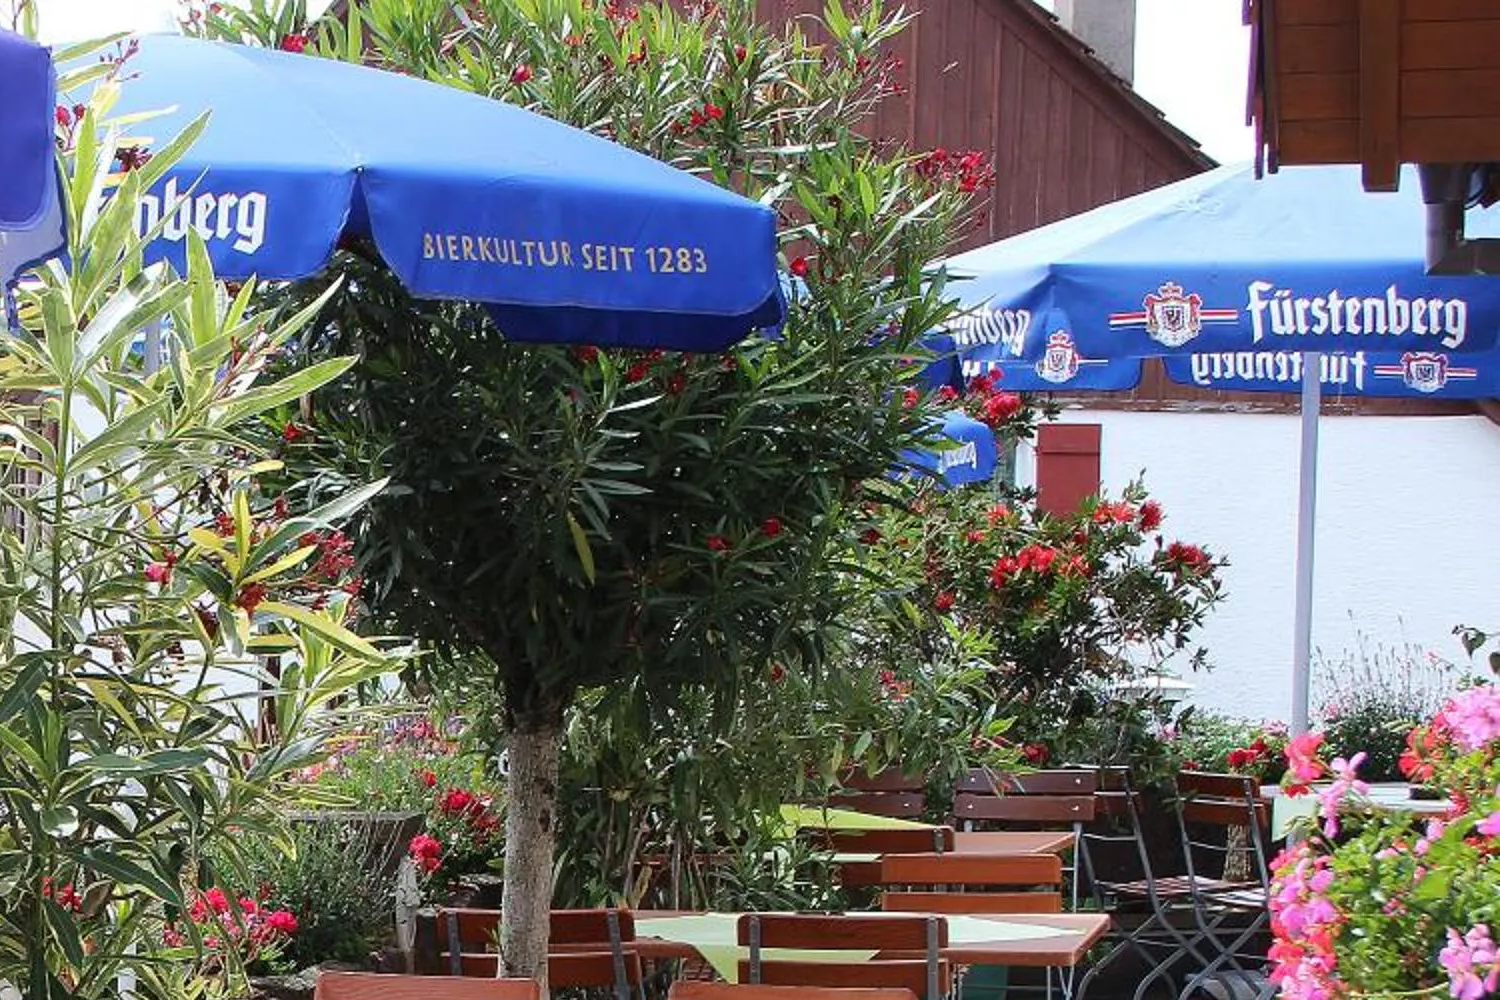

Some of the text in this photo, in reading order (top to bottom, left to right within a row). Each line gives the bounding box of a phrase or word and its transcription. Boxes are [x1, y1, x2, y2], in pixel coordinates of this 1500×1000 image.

[132, 176, 267, 254] nberg
[423, 233, 707, 273] BIERKULTUR SEIT 1283
[1246, 280, 1467, 349] Fürstenberg
